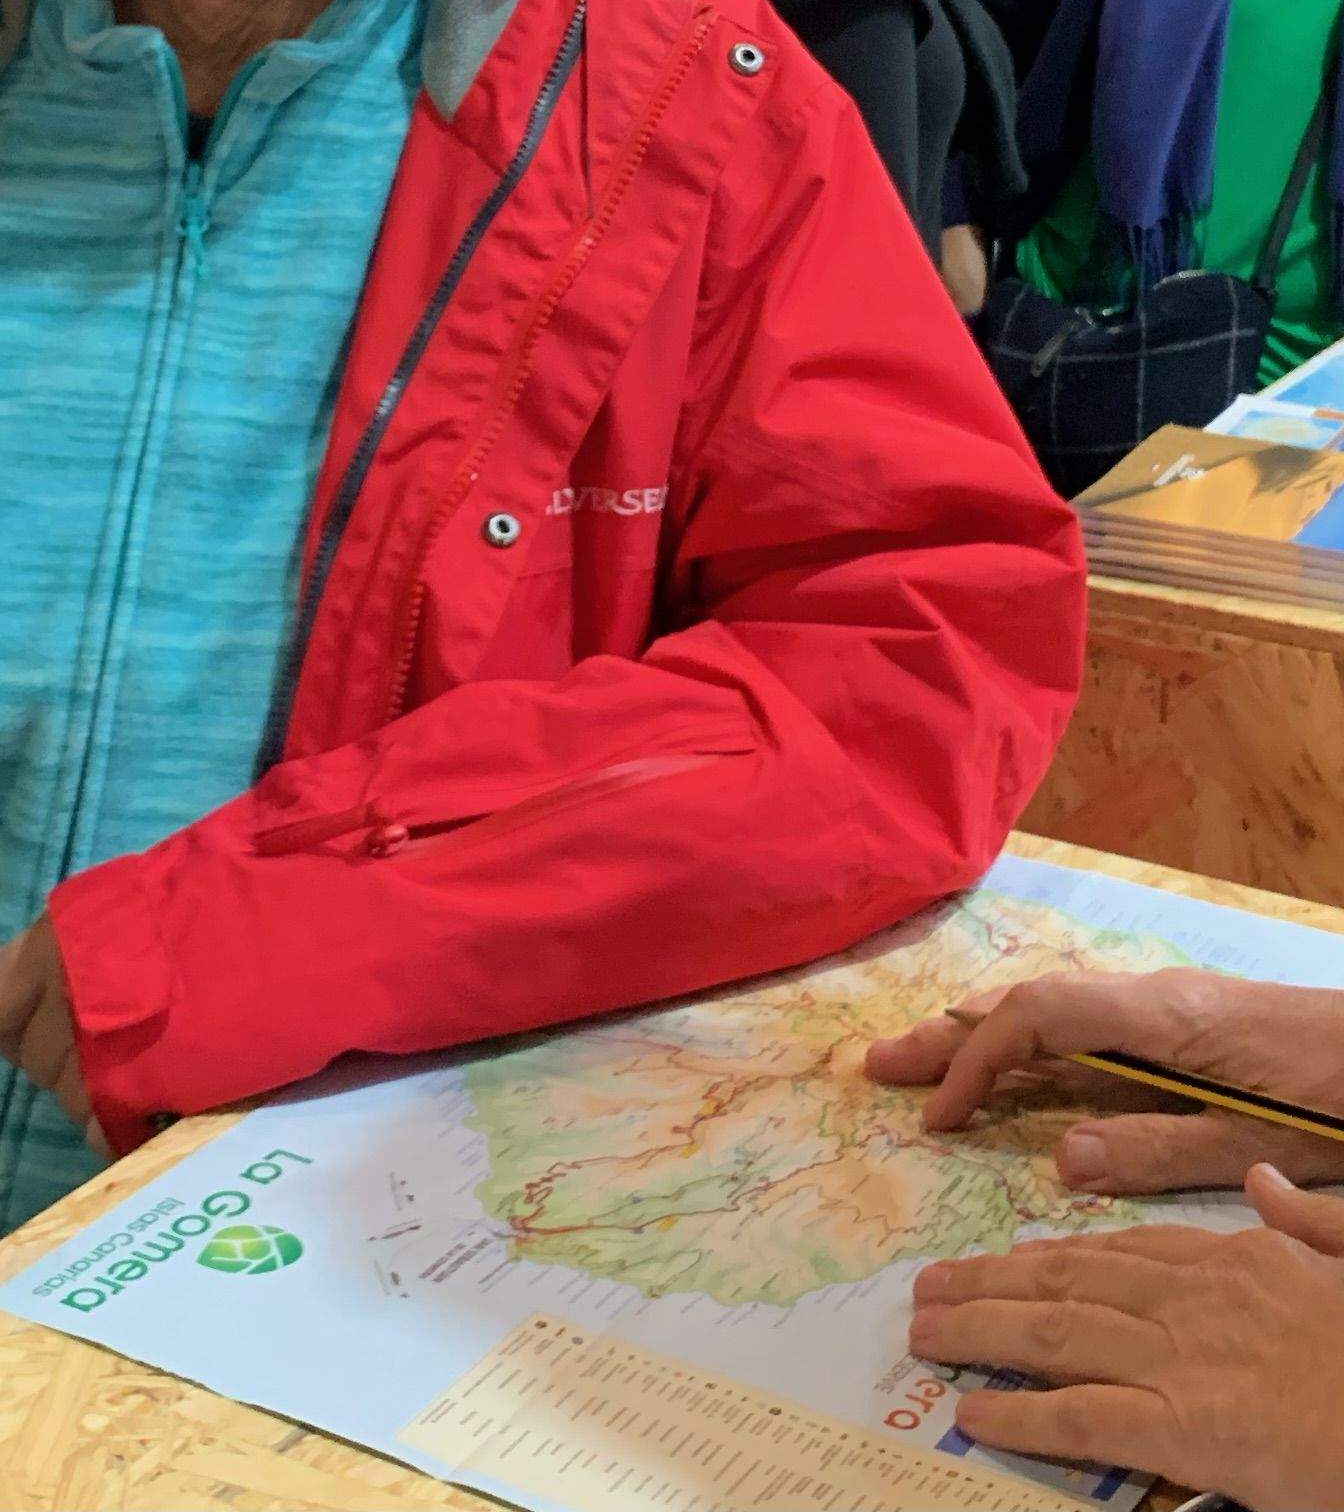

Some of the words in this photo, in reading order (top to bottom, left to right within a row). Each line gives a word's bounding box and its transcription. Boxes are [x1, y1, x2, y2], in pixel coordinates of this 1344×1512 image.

[239, 1149, 314, 1185] La
[127, 1196, 186, 1232] Islas
[32, 1232, 135, 1297] Canarias
[60, 1190, 251, 1313] Gomera
